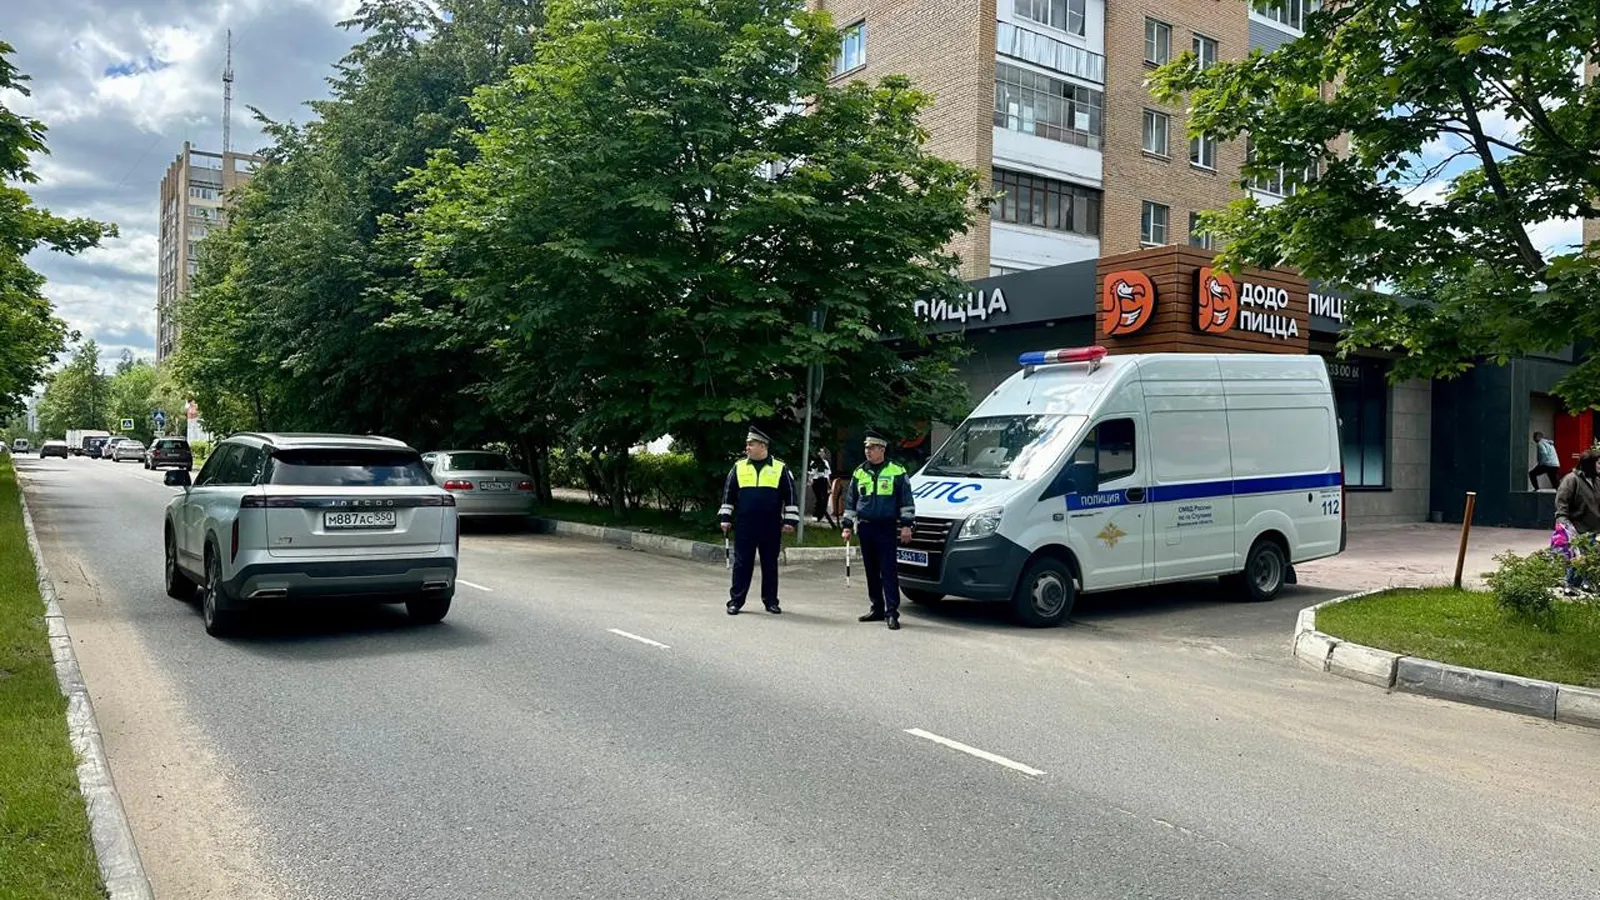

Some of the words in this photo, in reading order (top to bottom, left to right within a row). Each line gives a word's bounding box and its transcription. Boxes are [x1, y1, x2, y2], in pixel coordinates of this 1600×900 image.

[913, 287, 1007, 323] ПИЦЦА
[1240, 283, 1289, 311] ДОДО
[1308, 294, 1352, 323] ПИЦ
[1240, 311, 1299, 340] ПИЦЦА
[911, 481, 982, 504] ДПС
[1080, 493, 1120, 506] ПОЛИЦИЯ
[1322, 499, 1340, 516] 112
